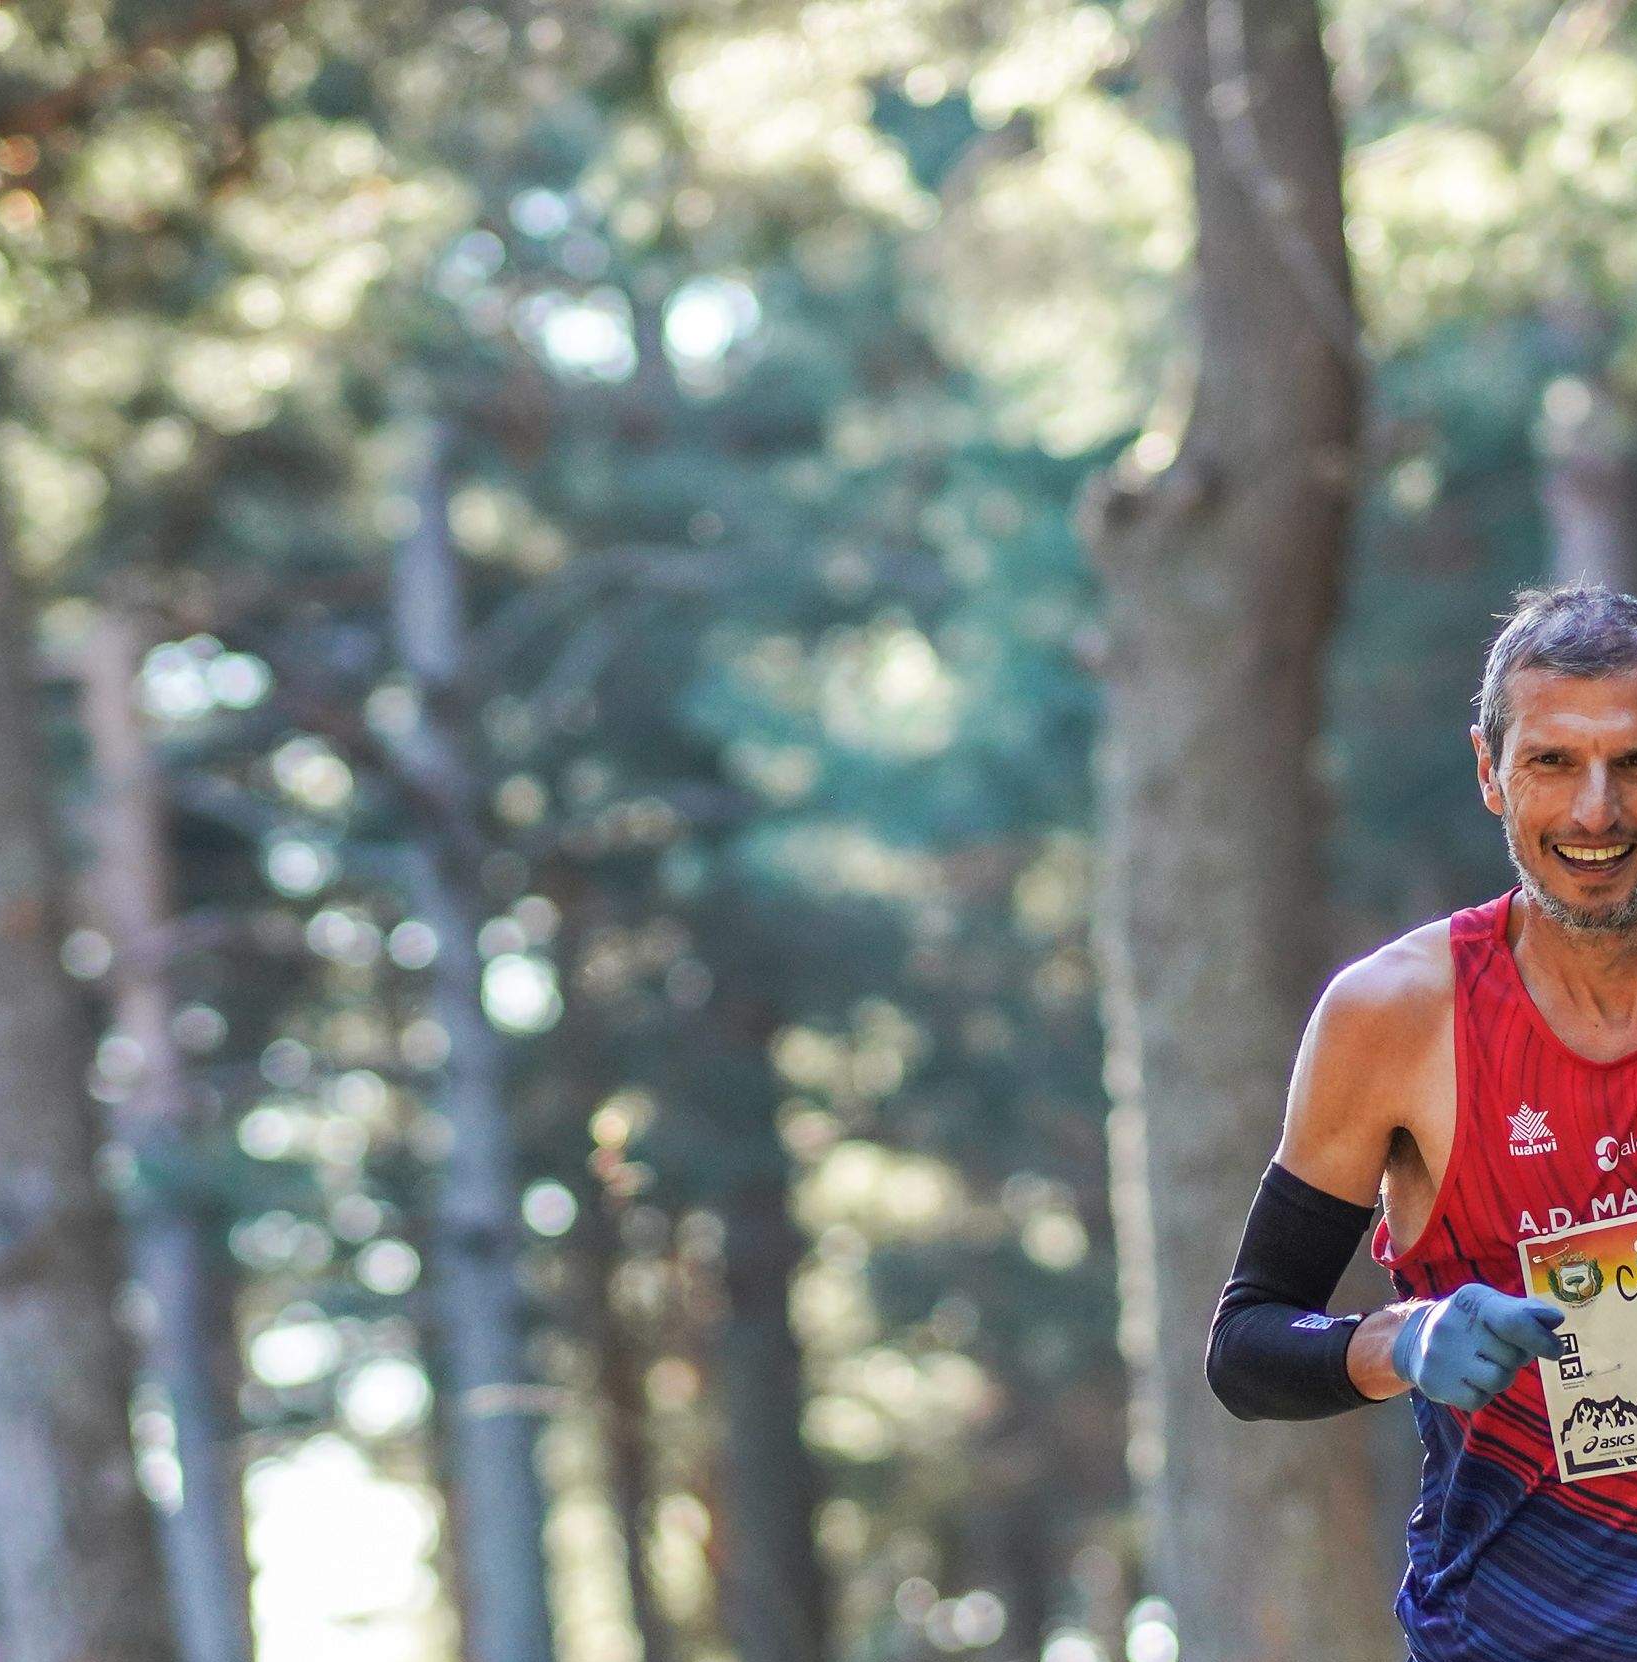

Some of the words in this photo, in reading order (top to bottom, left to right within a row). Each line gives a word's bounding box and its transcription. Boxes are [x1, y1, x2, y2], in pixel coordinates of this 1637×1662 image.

[1509, 1138, 1558, 1156] luanvi
[1518, 1207, 1581, 1235] A.D.
[1599, 1433, 1635, 1449] asics
